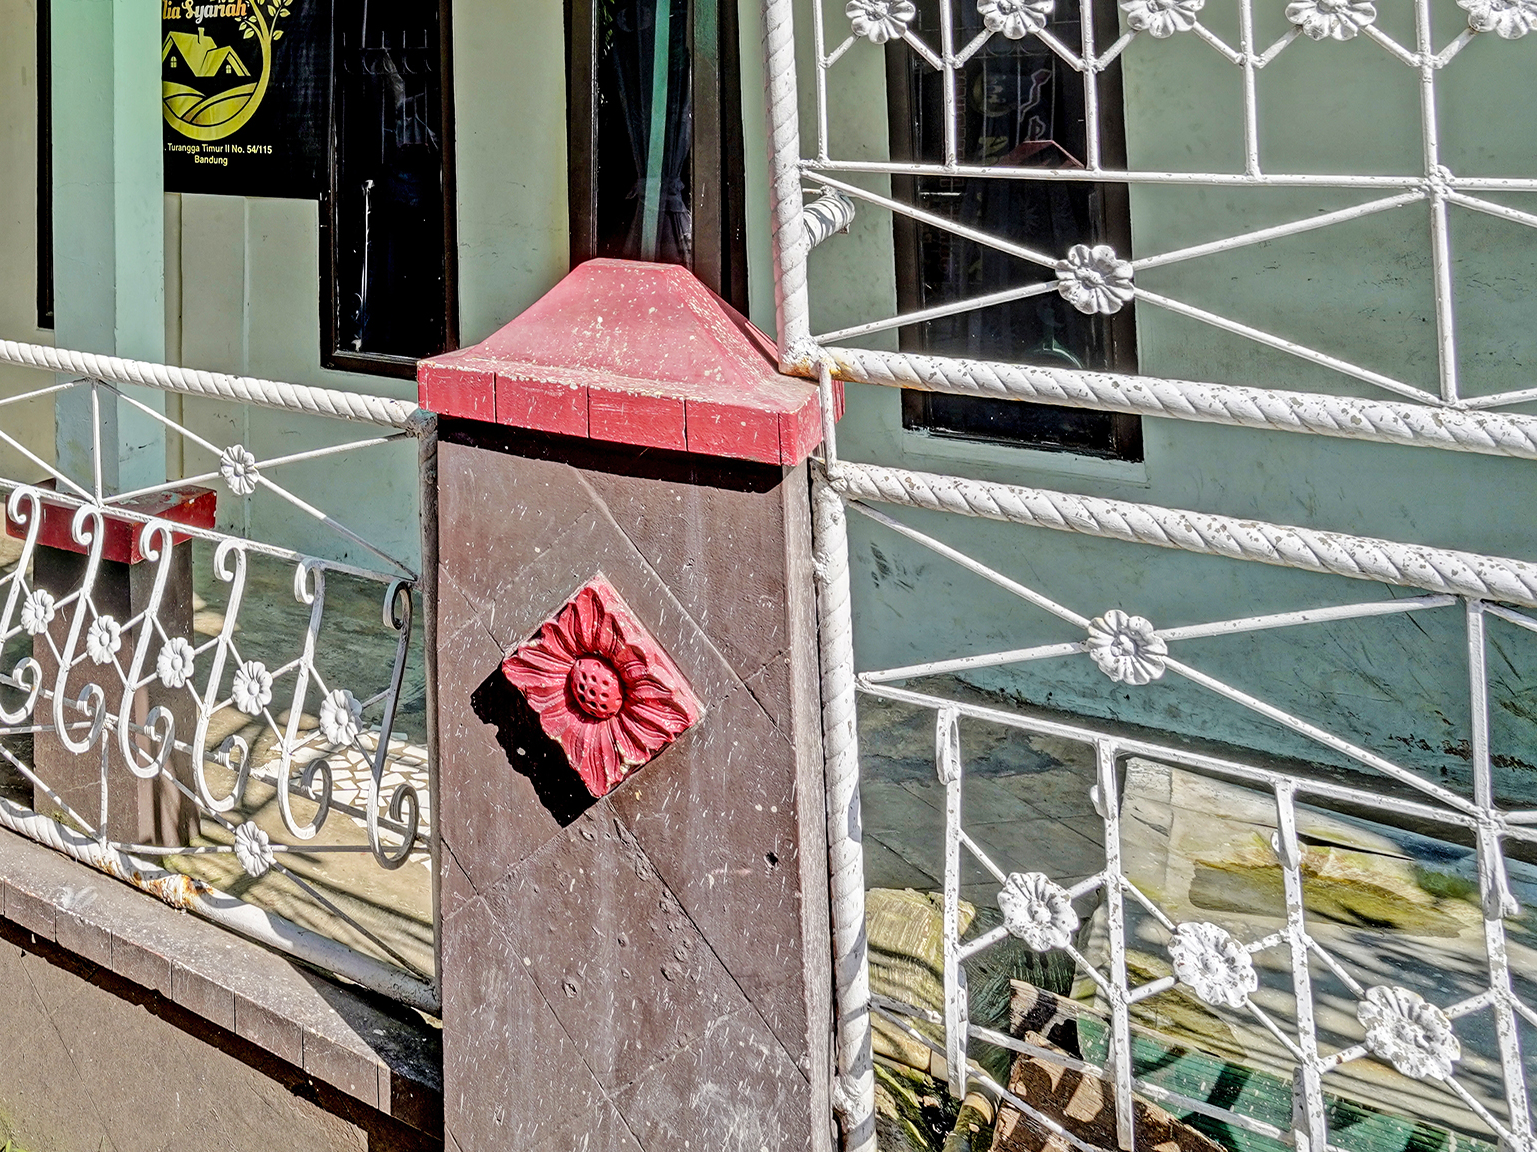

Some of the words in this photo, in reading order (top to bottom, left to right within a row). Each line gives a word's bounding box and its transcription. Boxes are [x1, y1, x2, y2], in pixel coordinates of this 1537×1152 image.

[162, 0, 181, 20] lia
[167, 142, 200, 154] Turangga
[202, 143, 223, 153] Timur
[231, 144, 245, 154] No.
[246, 144, 273, 154] 54/115
[194, 154, 228, 167] Bandung
